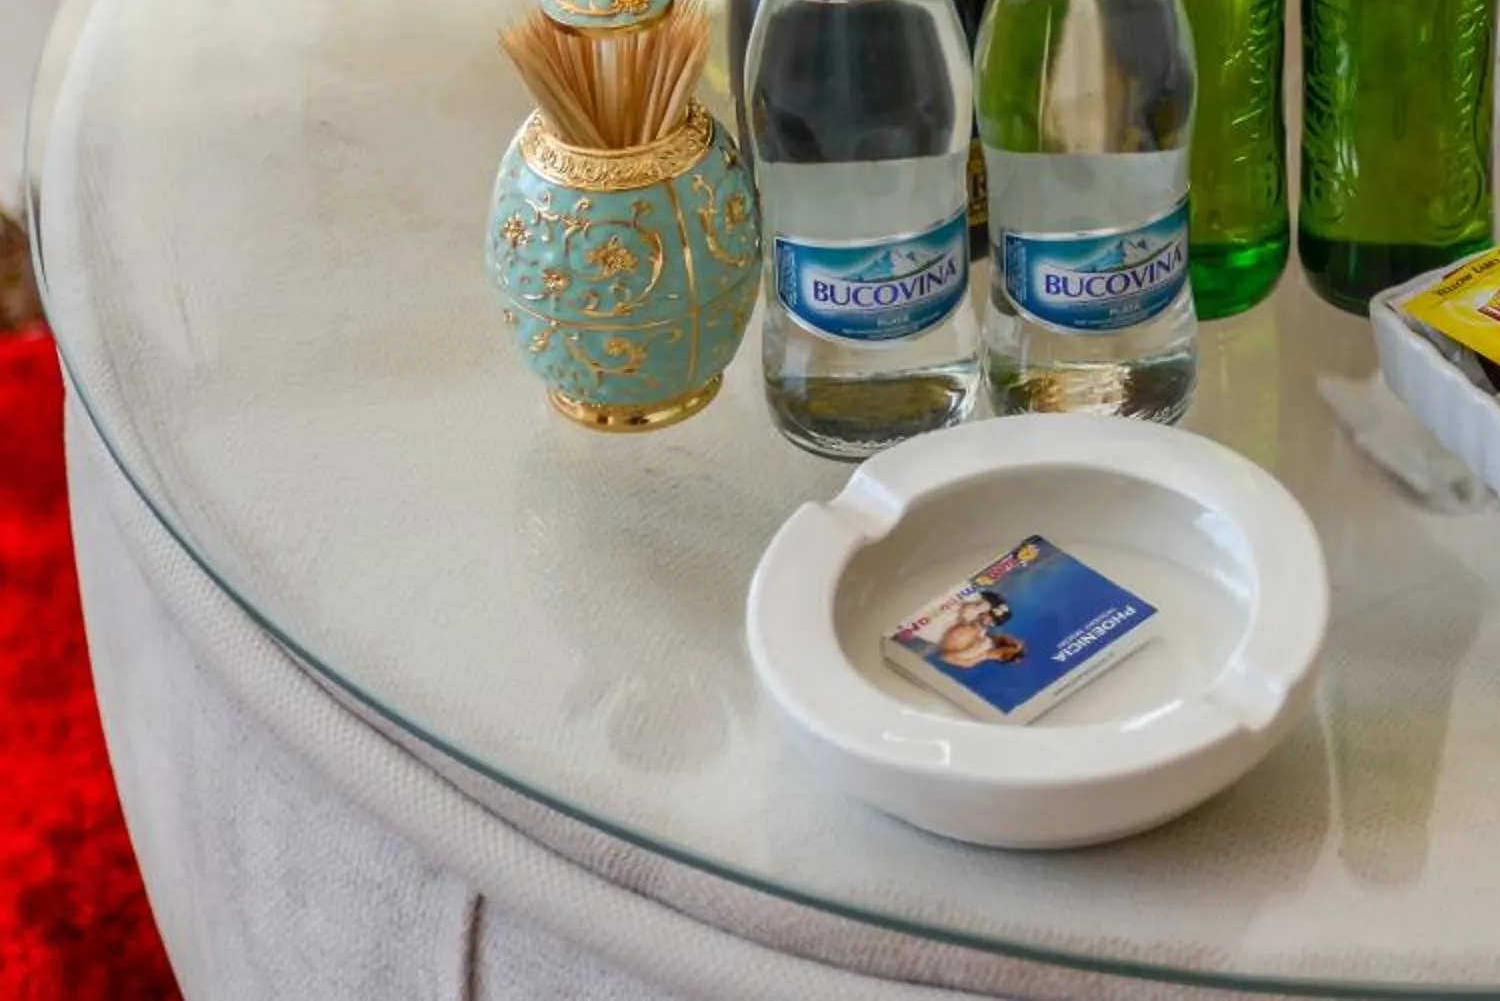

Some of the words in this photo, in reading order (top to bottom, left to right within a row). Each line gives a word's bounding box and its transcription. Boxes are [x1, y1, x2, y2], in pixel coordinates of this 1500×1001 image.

[813, 257, 957, 308] BUCOVINA
[1045, 246, 1183, 298] BUCOVINA
[1052, 604, 1137, 663] PHOENICIA
